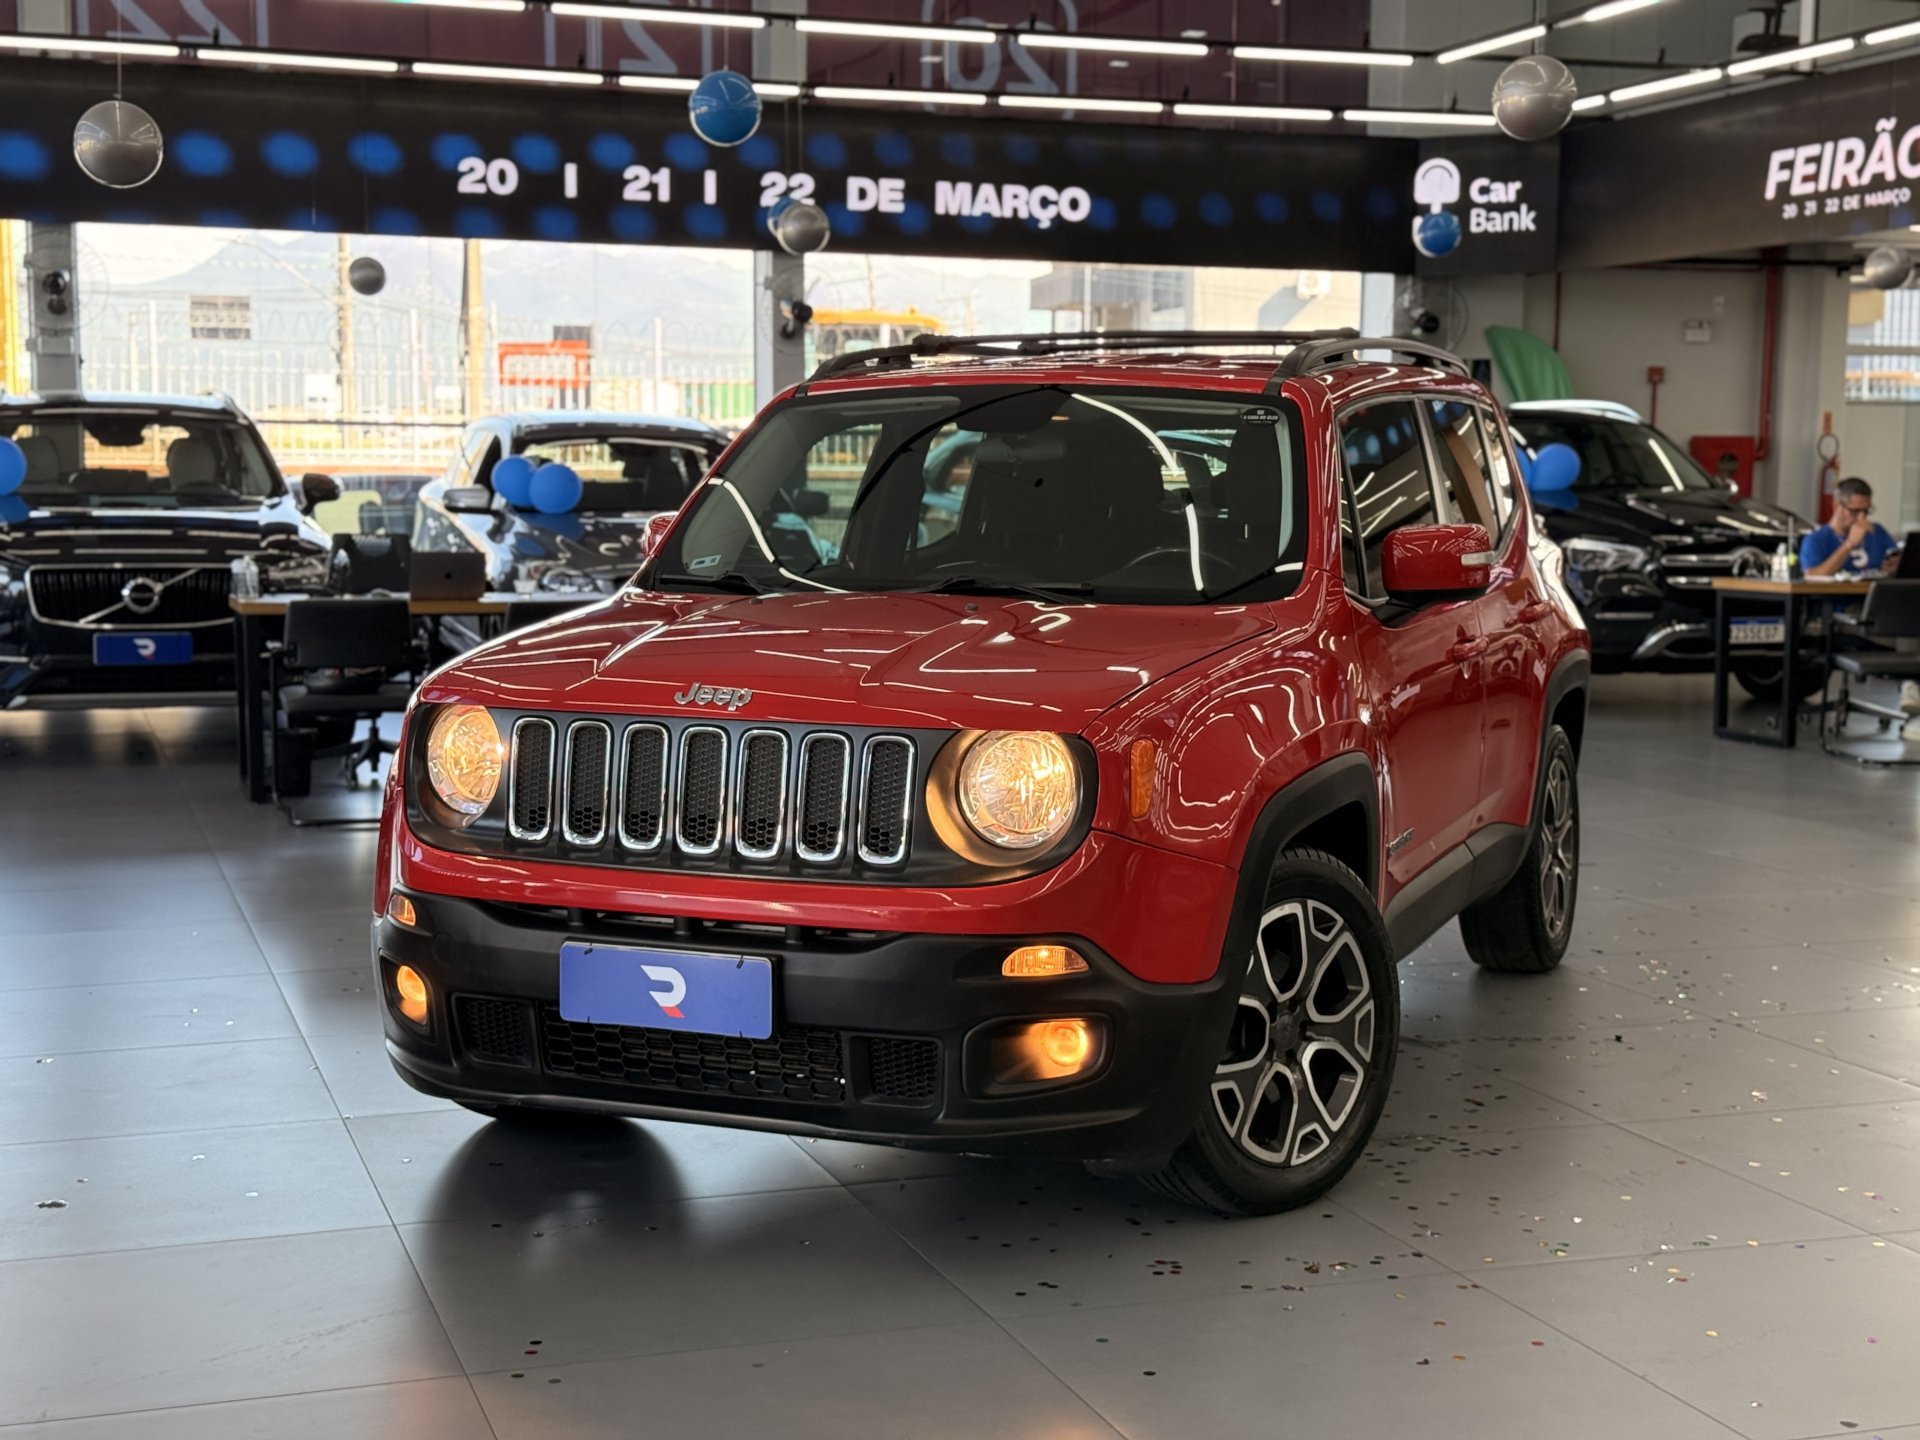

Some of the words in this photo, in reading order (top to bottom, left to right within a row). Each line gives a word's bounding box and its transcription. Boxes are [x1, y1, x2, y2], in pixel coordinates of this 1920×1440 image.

[457, 157, 519, 196] 20
[622, 164, 671, 203] 21
[760, 171, 816, 208] 22
[846, 176, 906, 213] DE
[934, 180, 1092, 229] MARÇO
[1469, 176, 1523, 204] Car
[1842, 193, 1861, 211] DE
[1864, 187, 1912, 208] MARÇO
[1469, 203, 1537, 234] Bank
[674, 682, 752, 711] Jeep
